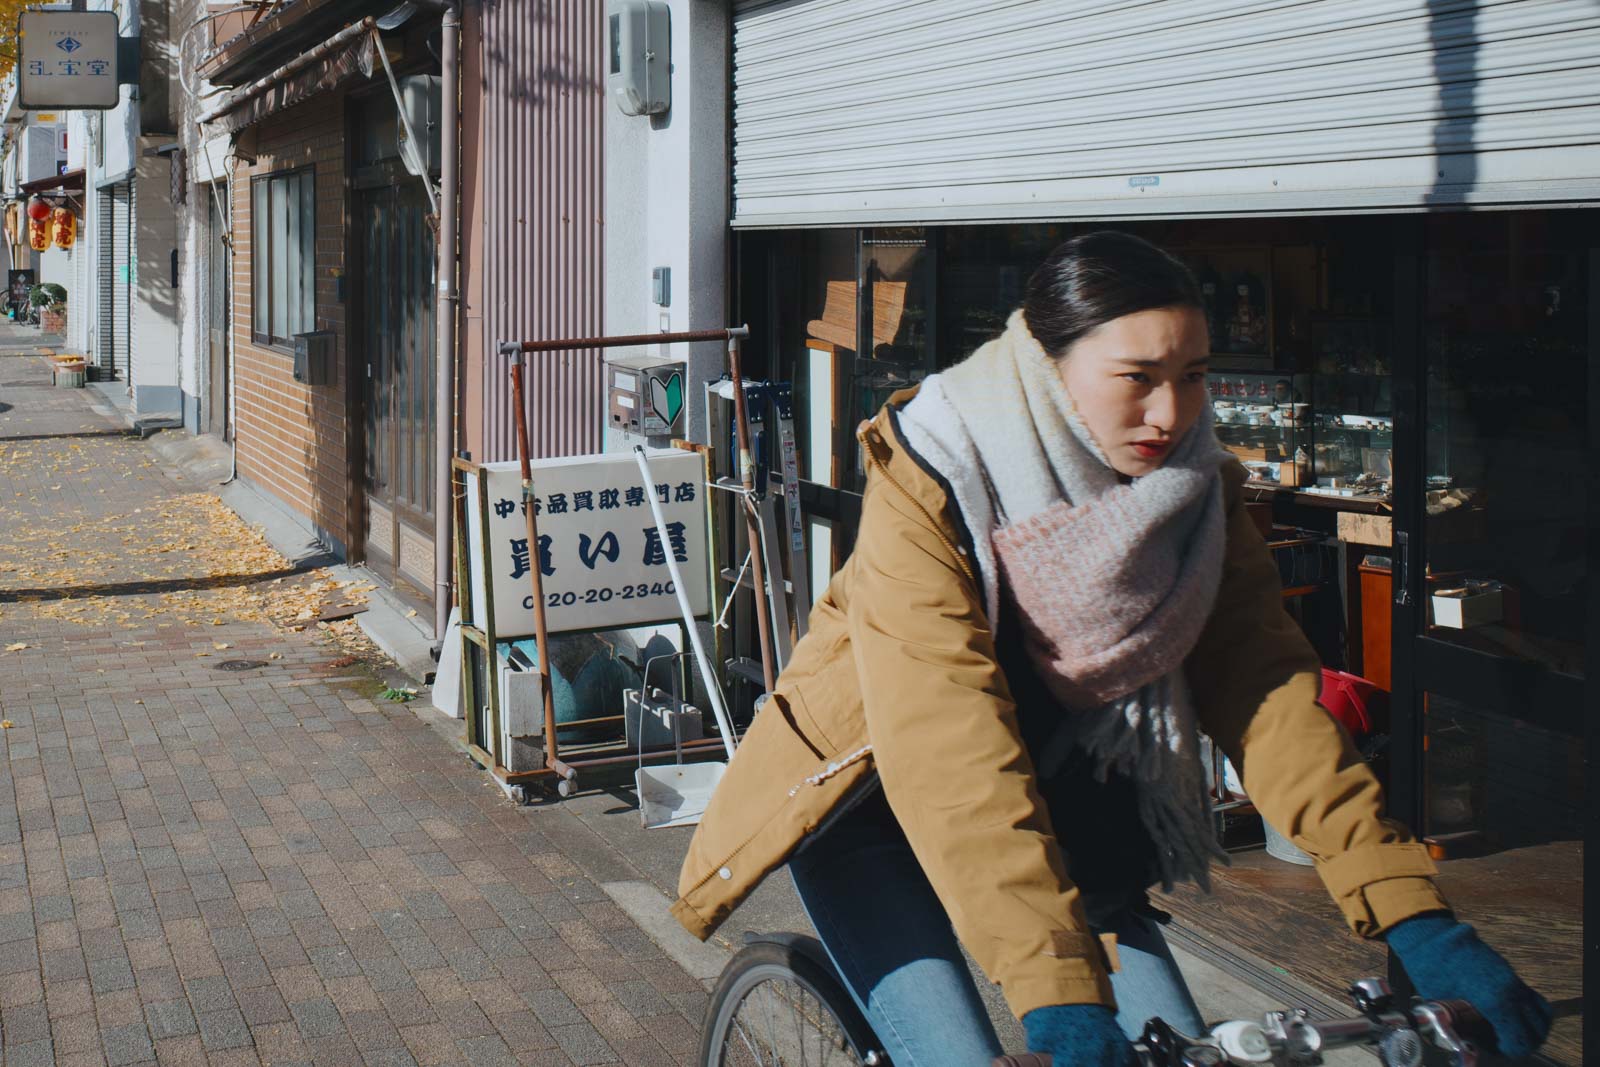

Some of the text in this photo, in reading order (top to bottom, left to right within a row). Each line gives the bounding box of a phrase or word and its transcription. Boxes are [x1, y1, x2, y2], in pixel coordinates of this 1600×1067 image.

[509, 521, 689, 580] 買い屋
[522, 580, 677, 610] 020-20-2340
